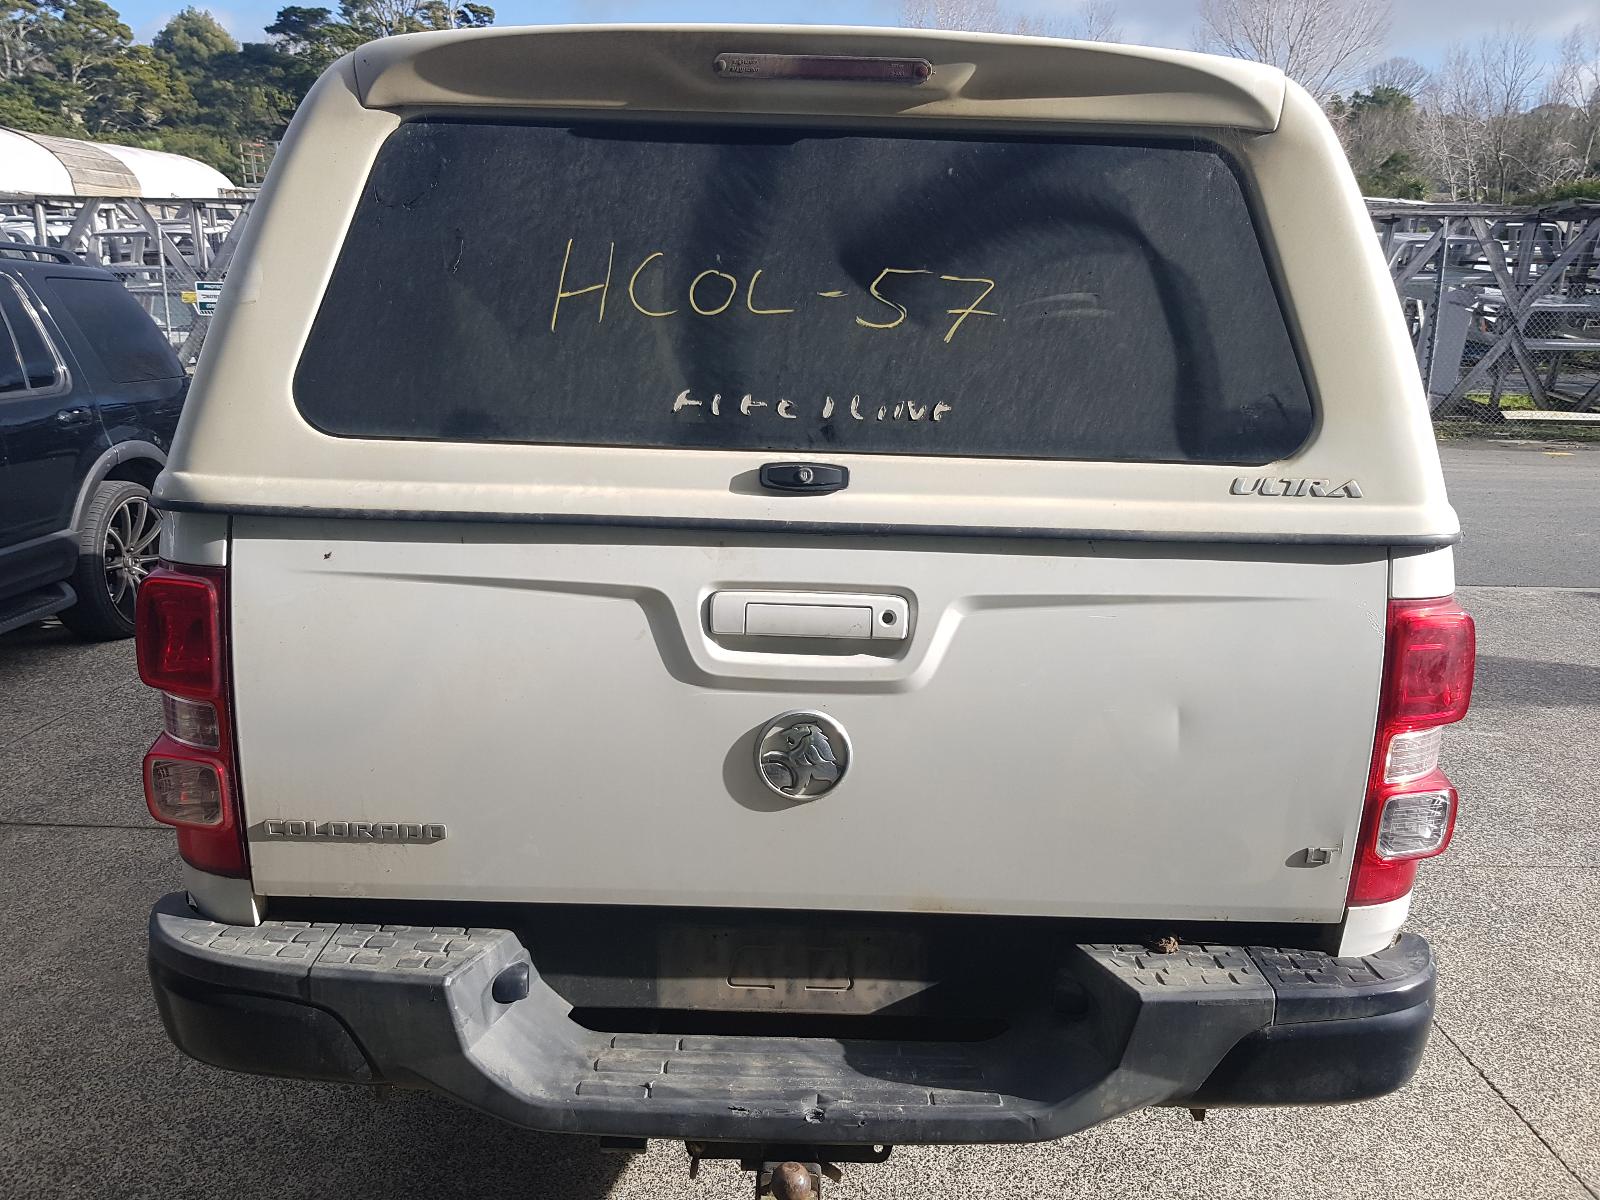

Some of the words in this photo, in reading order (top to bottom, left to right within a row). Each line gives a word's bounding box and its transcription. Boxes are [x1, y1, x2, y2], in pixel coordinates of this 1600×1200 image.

[1228, 476, 1363, 499] ULTRA
[263, 818, 448, 840] COLORADO
[1306, 847, 1340, 865] LT
